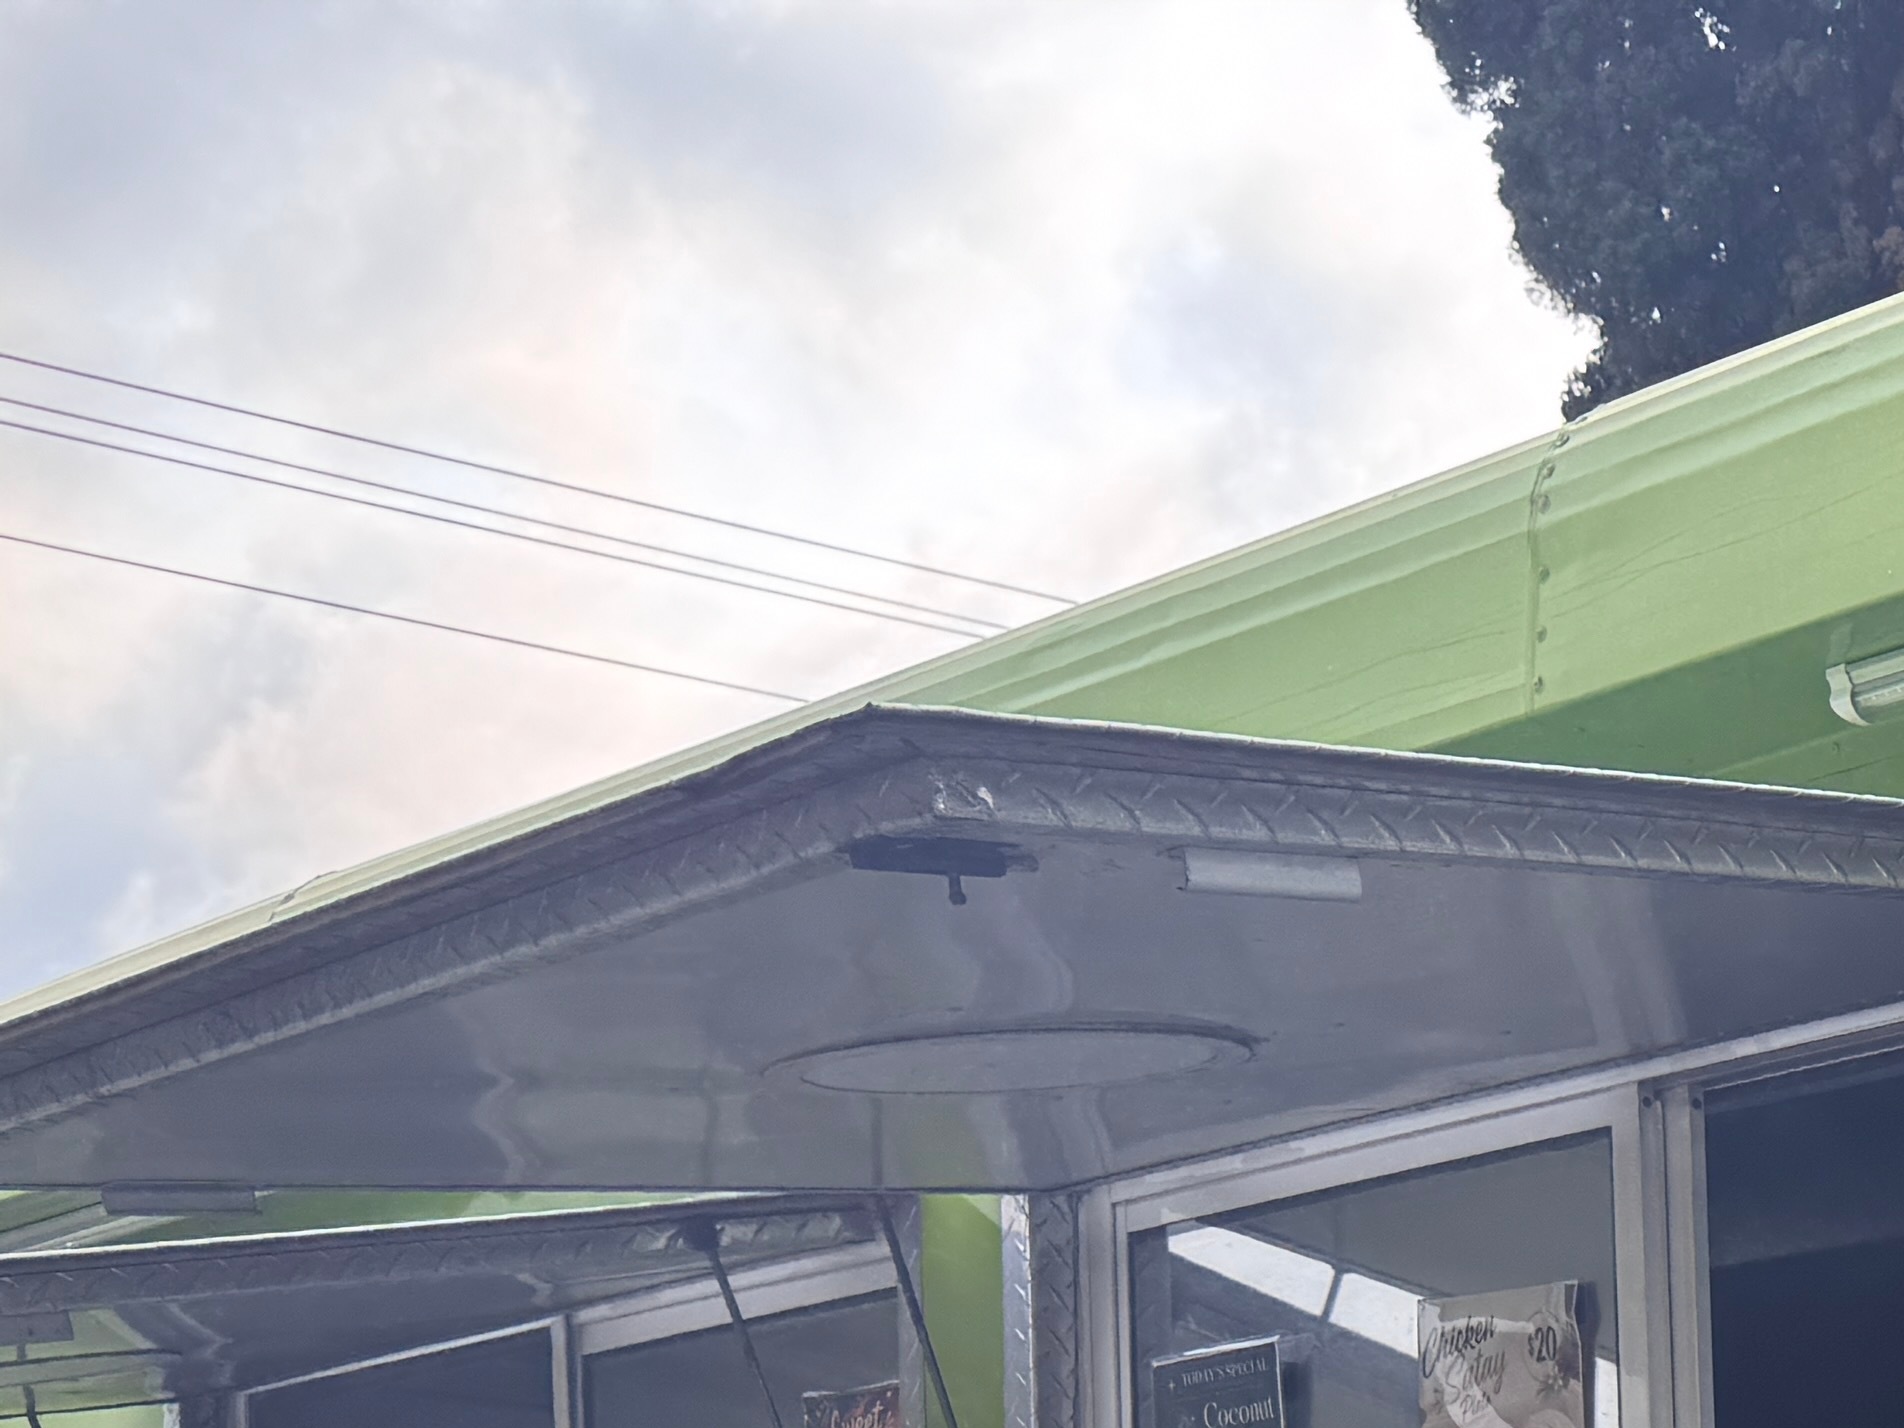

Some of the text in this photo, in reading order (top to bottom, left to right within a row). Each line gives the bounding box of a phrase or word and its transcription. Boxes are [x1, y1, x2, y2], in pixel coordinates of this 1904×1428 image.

[1422, 1315, 1496, 1379] Chicken
[1528, 1326, 1556, 1362] $20
[1447, 1350, 1505, 1405] Satay
[1203, 1397, 1275, 1428] Coconut
